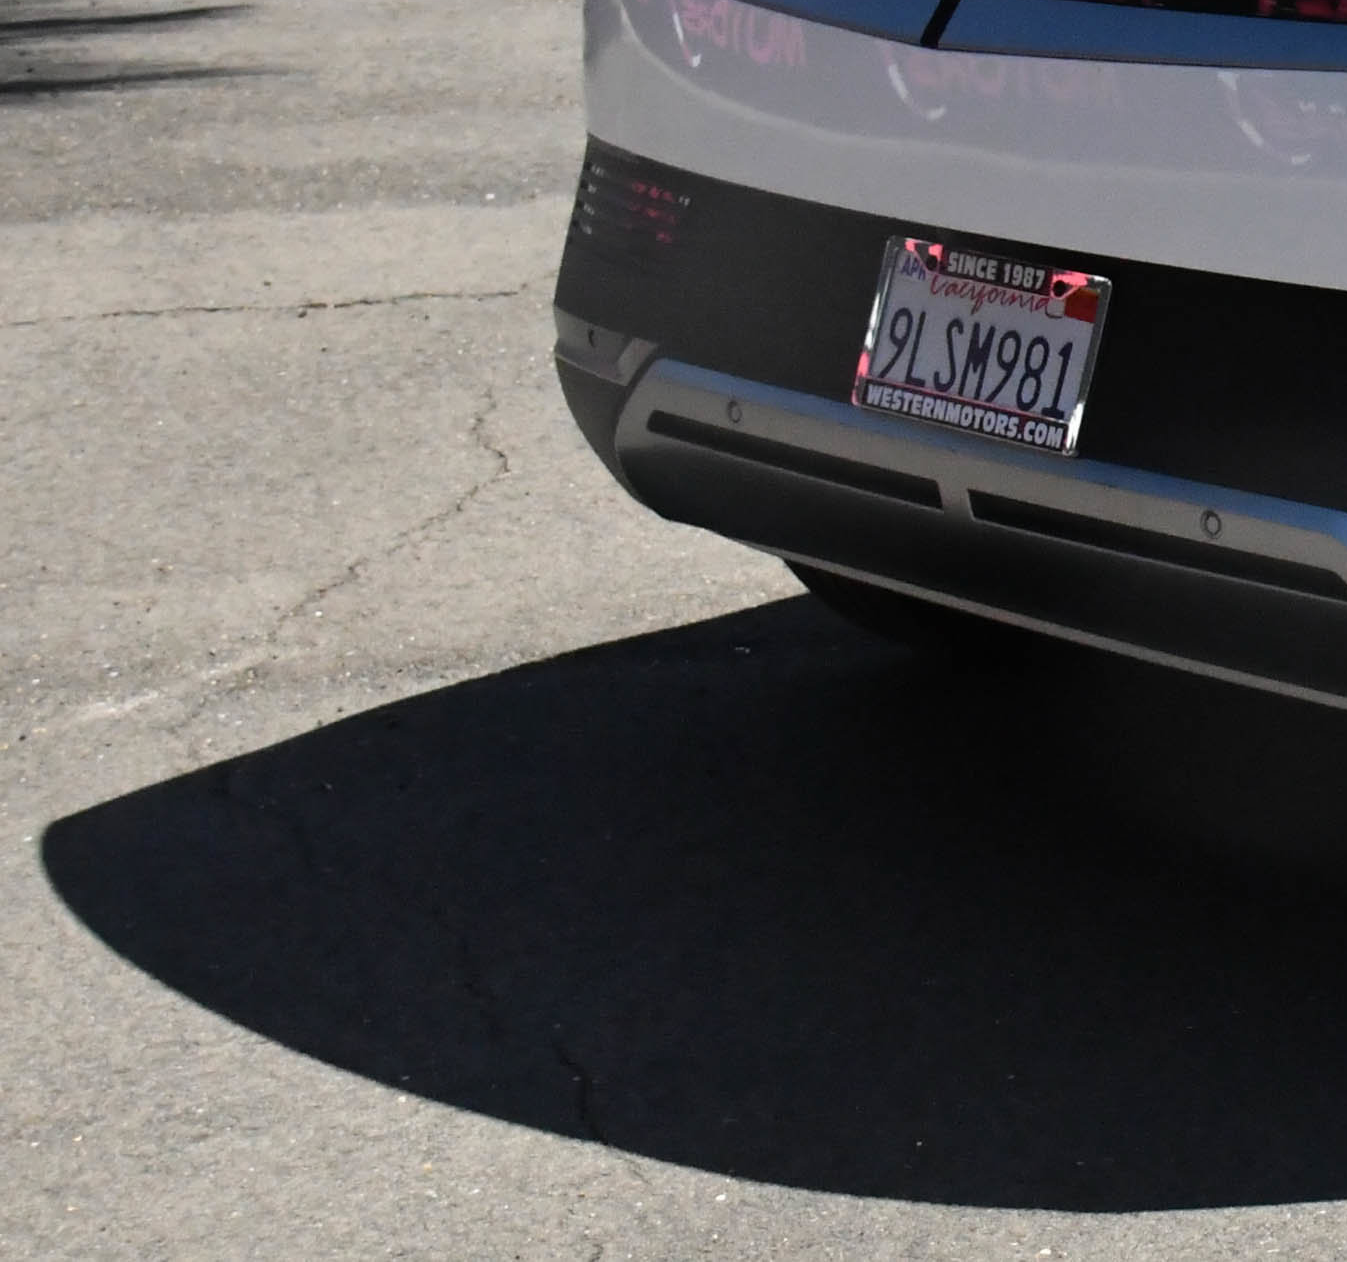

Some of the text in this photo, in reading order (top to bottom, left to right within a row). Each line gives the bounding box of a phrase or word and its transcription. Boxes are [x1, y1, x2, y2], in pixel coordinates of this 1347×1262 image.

[947, 251, 1046, 290] SINCE 1987
[879, 307, 1074, 421] 9LSM981
[866, 385, 1064, 449] WESTERNMOTORS.COM
